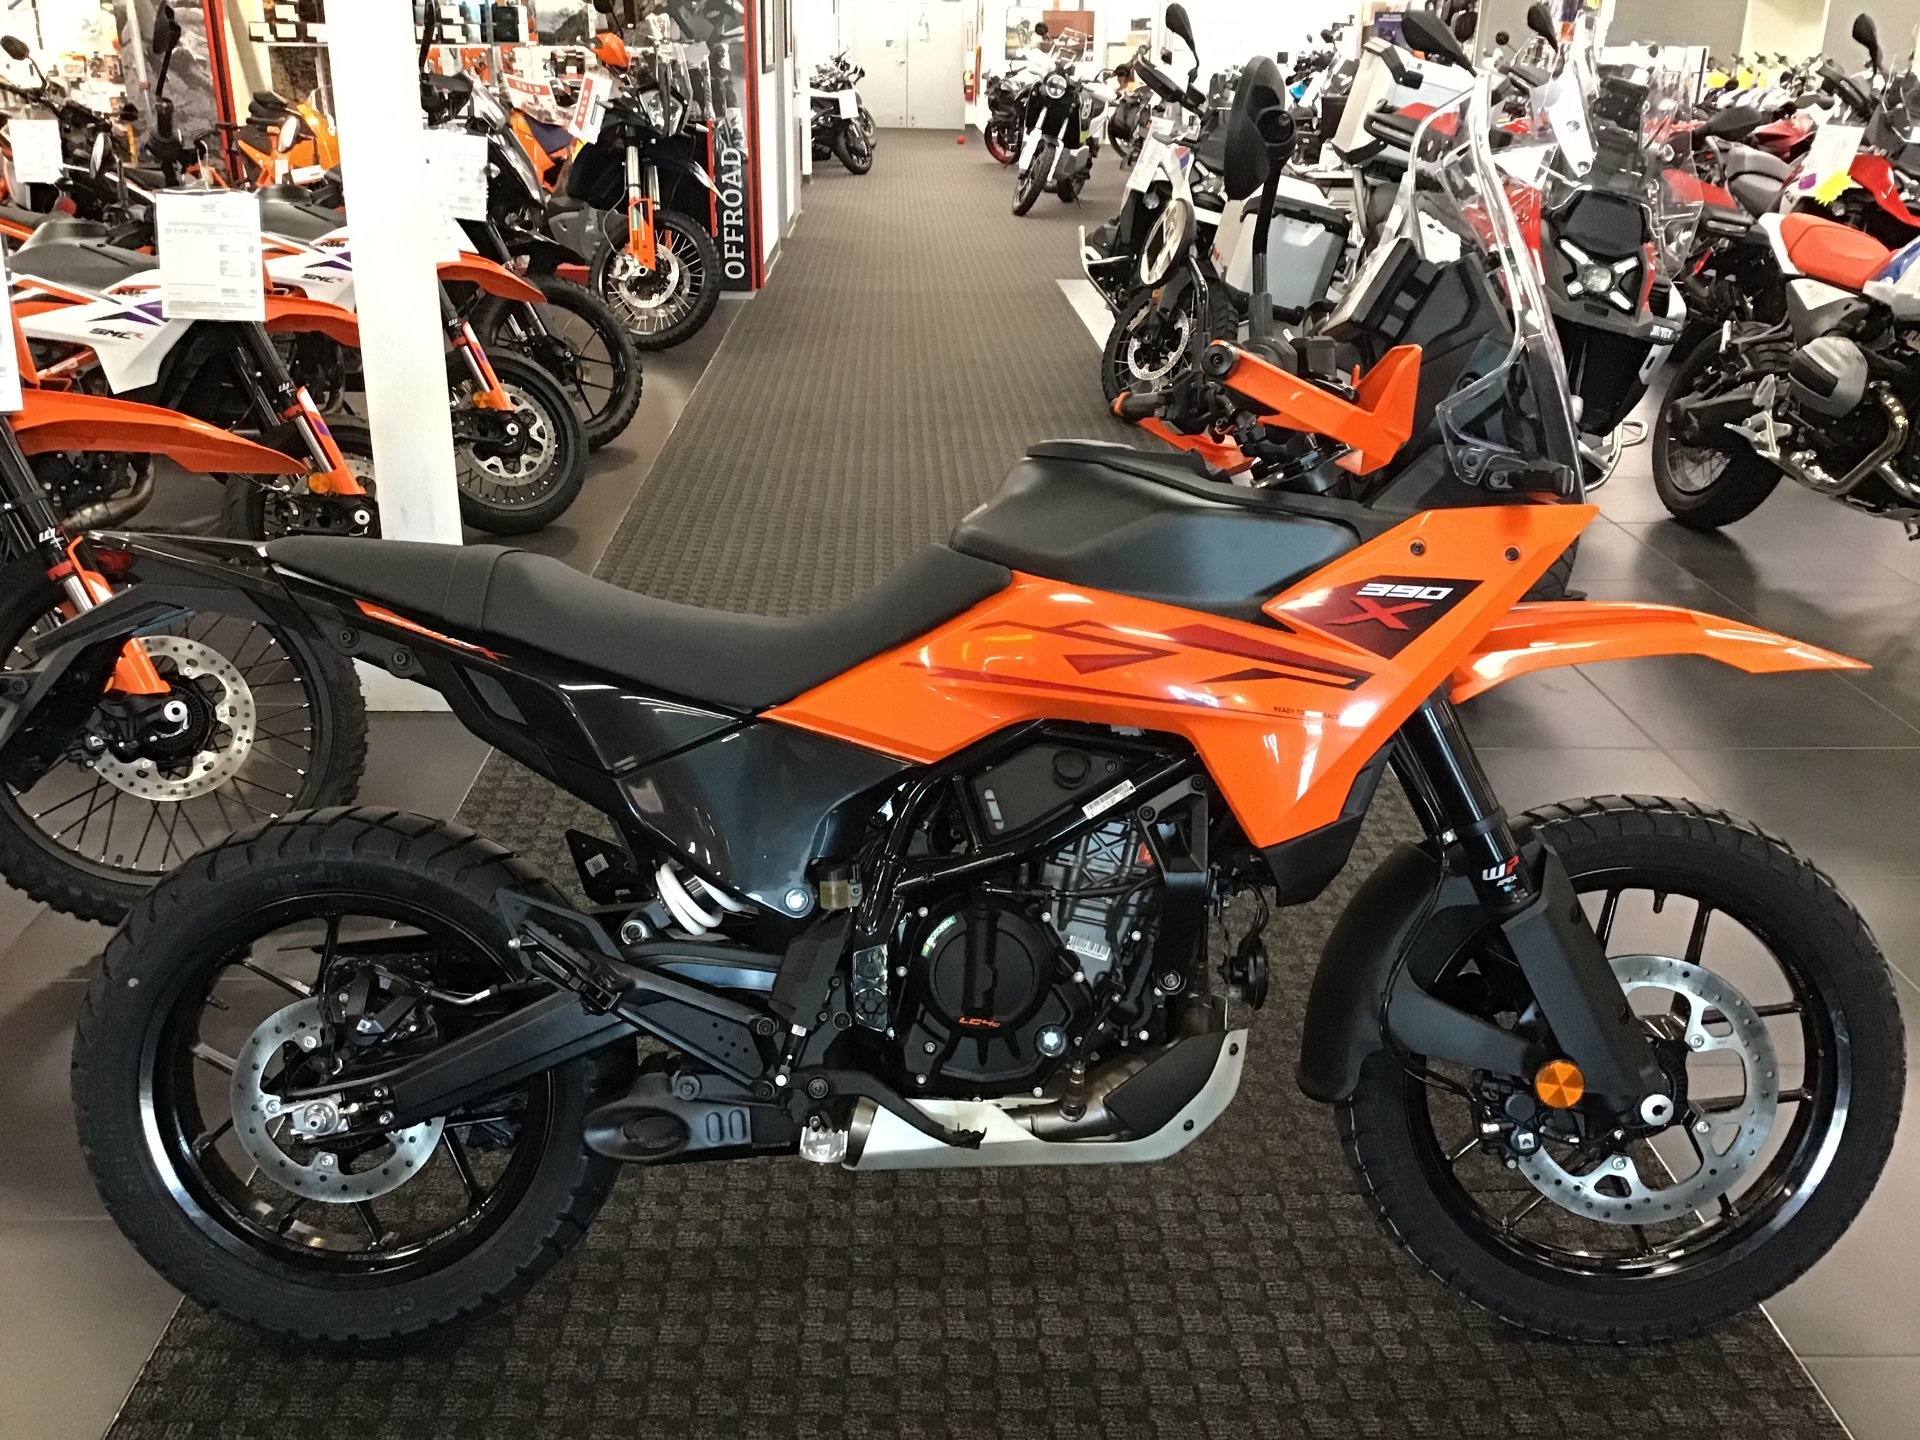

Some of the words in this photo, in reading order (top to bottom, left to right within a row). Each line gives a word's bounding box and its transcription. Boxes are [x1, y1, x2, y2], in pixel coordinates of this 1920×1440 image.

[515, 81, 541, 93] SOLD
[577, 90, 590, 122] SOLD
[720, 147, 745, 280] OFFROAD
[1356, 582, 1454, 600] 390
[1325, 598, 1433, 630] X
[1273, 706, 1295, 715] READY
[1482, 855, 1519, 881] WP
